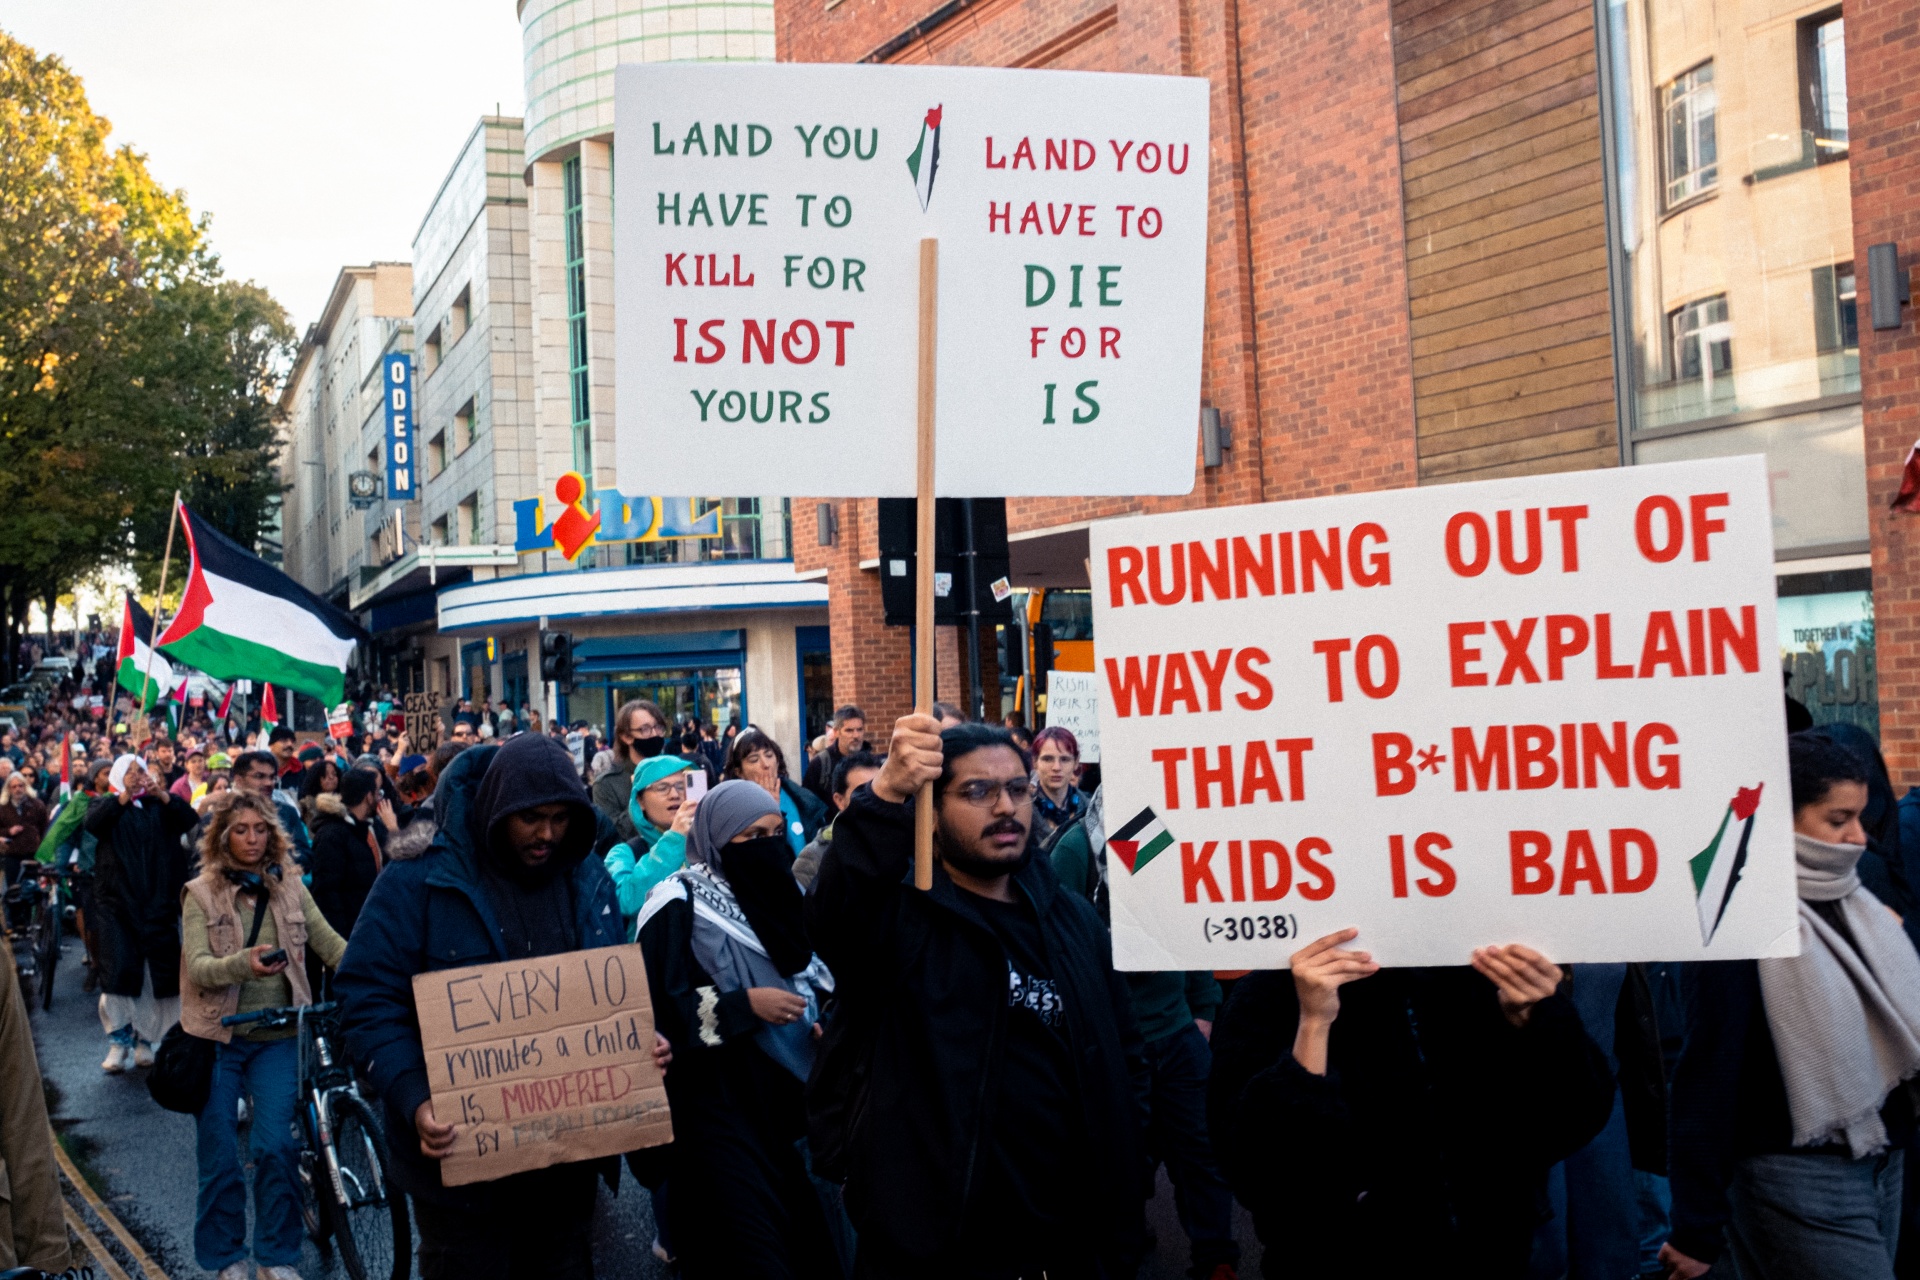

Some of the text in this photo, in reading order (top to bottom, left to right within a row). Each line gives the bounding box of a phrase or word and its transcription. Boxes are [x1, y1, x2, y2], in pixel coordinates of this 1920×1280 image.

[652, 122, 878, 160] LAND YOU
[985, 136, 1189, 175] LAND YOU
[657, 192, 852, 228] HAVE TO
[988, 201, 1163, 239] HAVE TO
[665, 252, 867, 292] KILL FOR
[1024, 264, 1123, 308] DIE
[673, 318, 855, 367] IS NOT
[1029, 326, 1122, 359] FOR
[690, 389, 831, 424] YOURS
[1043, 380, 1101, 424] IS
[391, 361, 410, 491] ODEON
[1107, 493, 1729, 608] RUNNING OUT OF
[1793, 625, 1853, 642] TOGETHER WE
[1104, 605, 1760, 718] WAYS TO EXPLAIN
[405, 691, 439, 713] CEASE
[1053, 698, 1080, 710] KEIR
[1057, 716, 1080, 726] WAR
[406, 712, 439, 735] FIRE
[406, 733, 439, 755] NOW
[1152, 738, 1314, 810] THAT
[1180, 828, 1659, 903] KIDS IS BAD
[1204, 914, 1298, 942] (>3038)
[447, 955, 626, 1033] EVERY 10
[444, 1037, 543, 1085] minutes
[556, 1036, 570, 1057] a
[461, 1066, 632, 1125] IS MURDERED
[475, 1130, 499, 1157] BY
